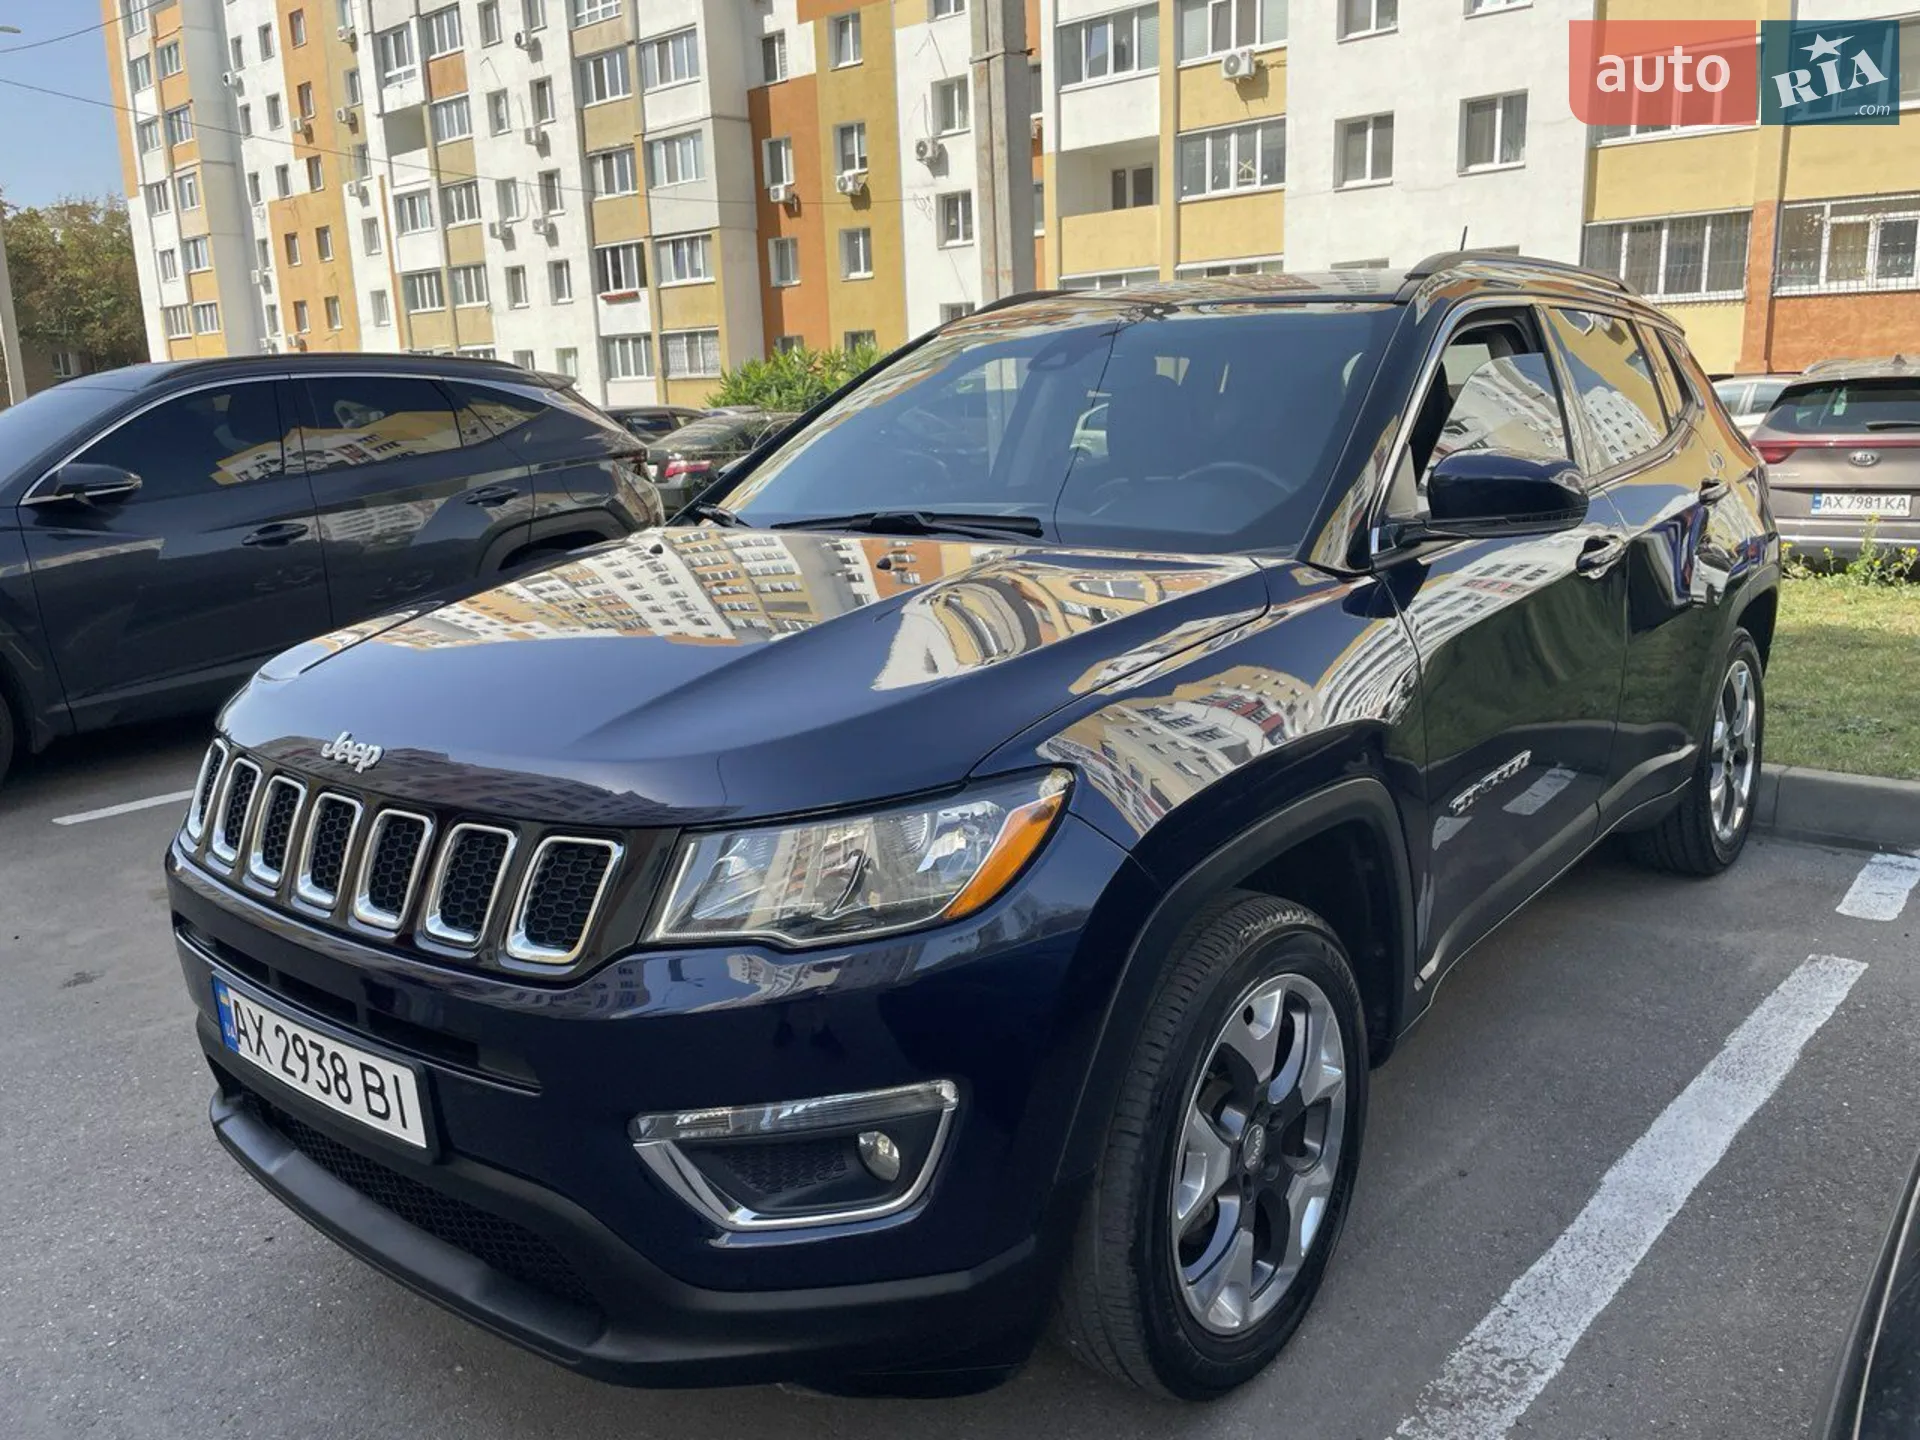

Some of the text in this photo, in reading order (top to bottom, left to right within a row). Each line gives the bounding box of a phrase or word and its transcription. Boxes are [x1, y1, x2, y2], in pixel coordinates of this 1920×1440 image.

[1822, 495, 1907, 511] AX 7981 KA
[321, 731, 384, 774] Jeep
[233, 999, 408, 1130] AX 2938 BI
